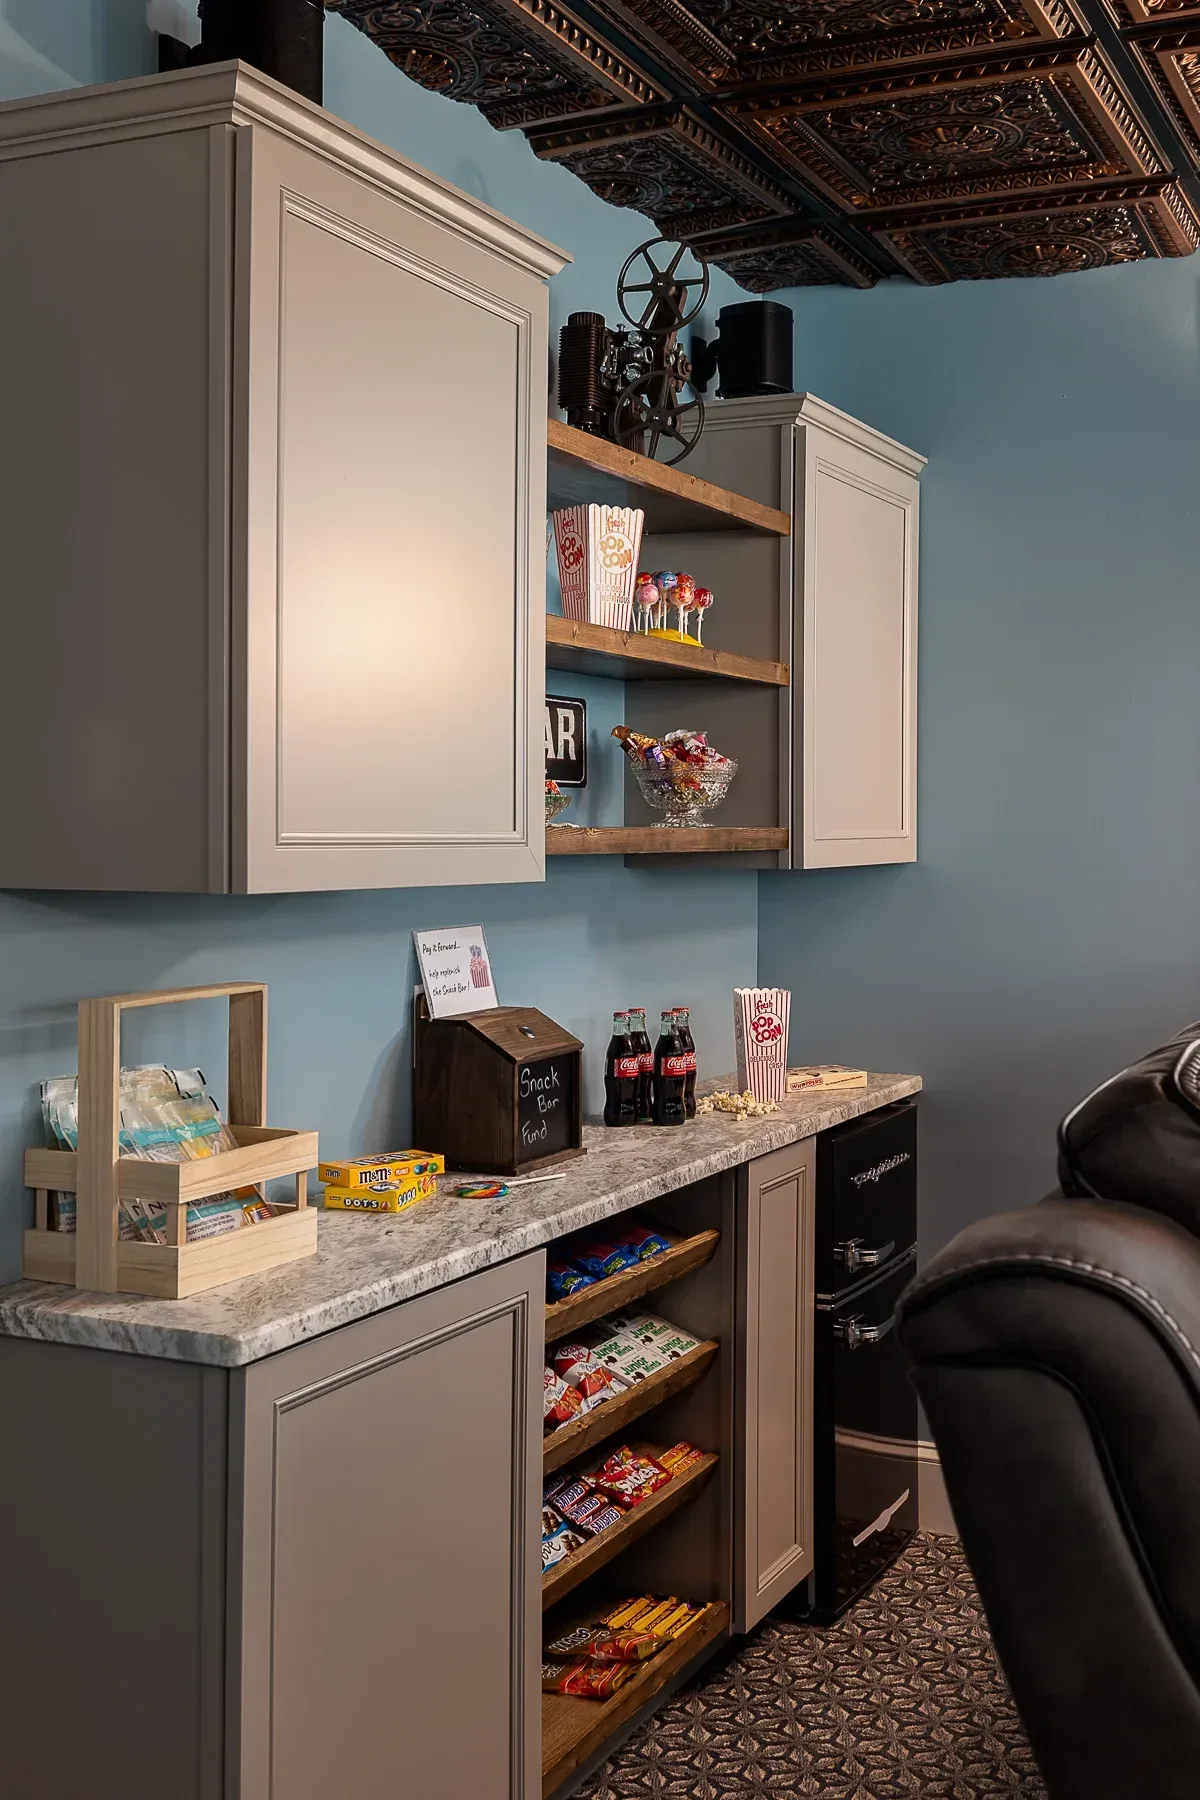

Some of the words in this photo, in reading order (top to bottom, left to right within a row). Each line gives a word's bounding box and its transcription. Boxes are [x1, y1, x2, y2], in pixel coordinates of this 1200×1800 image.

[560, 536, 576, 557] POP
[600, 536, 624, 555] POP
[564, 544, 584, 569] CORN
[603, 548, 632, 569] CORN
[422, 944, 431, 955] Pay
[429, 969, 439, 979] help
[756, 1000, 773, 1013] fresh
[752, 1016, 773, 1033] POP
[756, 1023, 781, 1043] CORN
[750, 1055, 774, 1063] DELICIOUS
[769, 1062, 783, 1070] CRISP
[520, 1066, 560, 1098] Snack
[537, 1094, 559, 1113] Bar
[521, 1120, 548, 1146] Fund
[345, 1198, 378, 1208] DOTS
[630, 1321, 656, 1339] Junior
[651, 1325, 669, 1336] Mints
[593, 1341, 621, 1359] Junior
[615, 1345, 634, 1357] Mints
[657, 1337, 683, 1354] Junior
[678, 1340, 696, 1351] Mints
[620, 1356, 648, 1375] Junior
[642, 1361, 661, 1373] Mints
